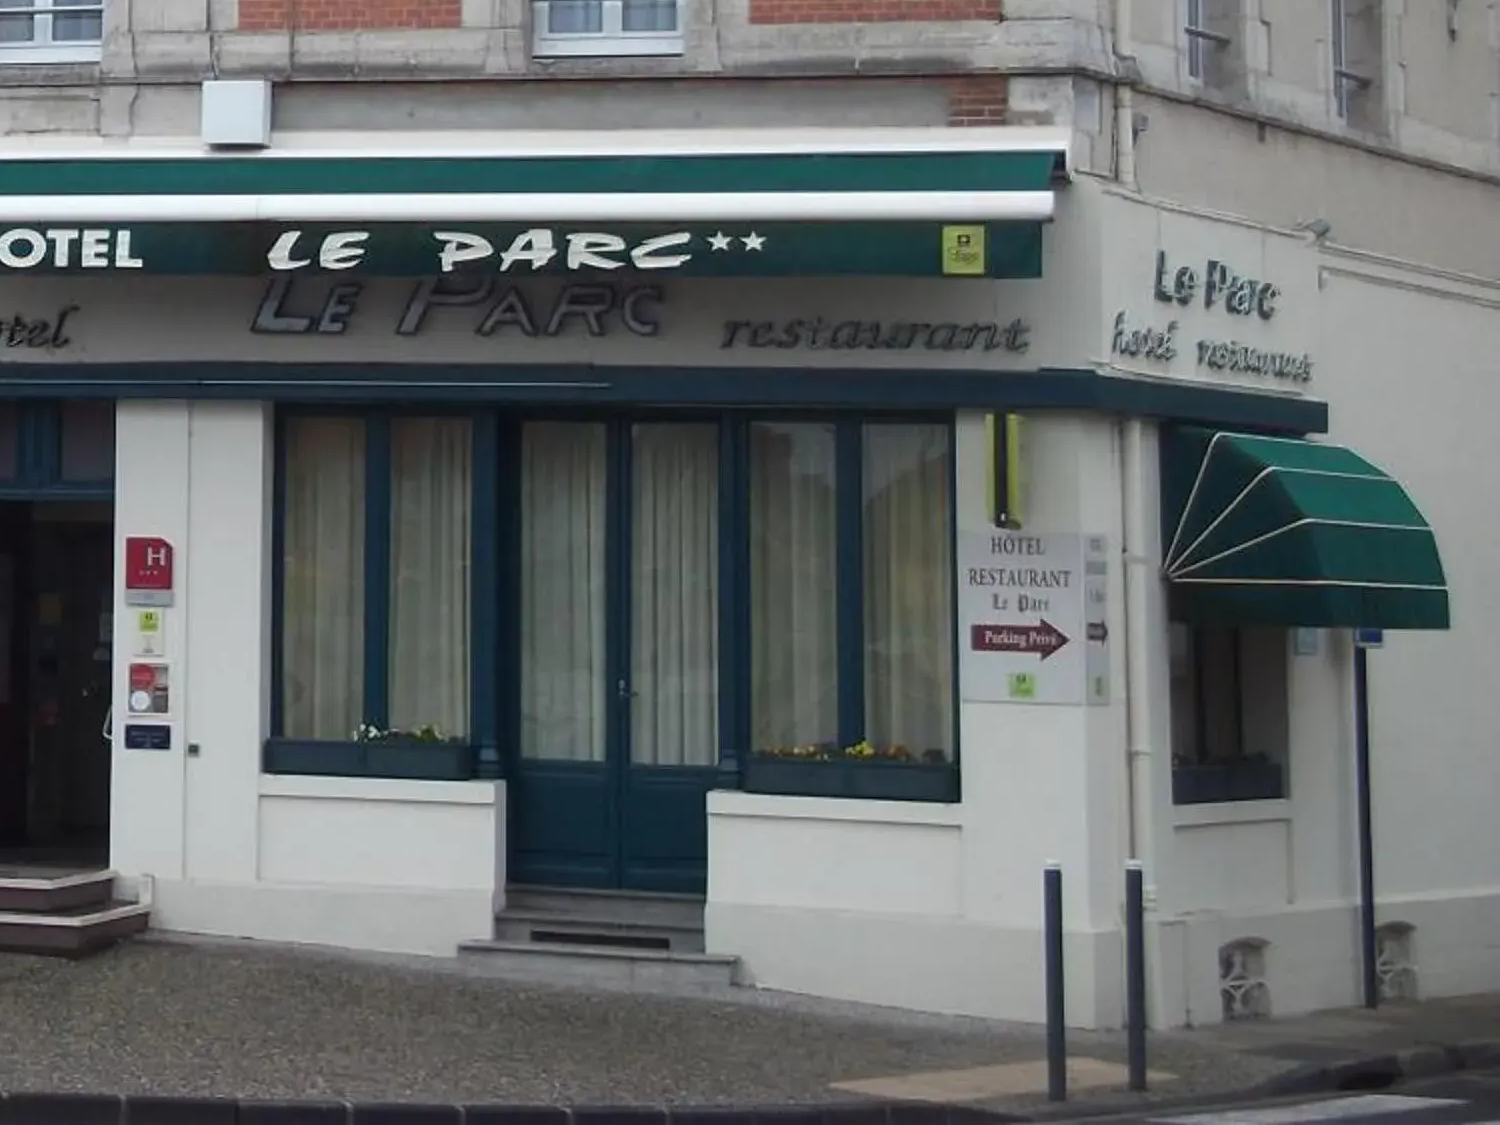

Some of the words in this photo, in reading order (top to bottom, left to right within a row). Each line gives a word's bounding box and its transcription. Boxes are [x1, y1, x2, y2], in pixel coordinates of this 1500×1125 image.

[266, 230, 370, 271] LE
[431, 228, 692, 272] PARC
[718, 314, 1032, 354] restaurant
[147, 547, 165, 567] H
[968, 567, 1072, 588] RESTAURANT
[985, 630, 1026, 649] Parking
